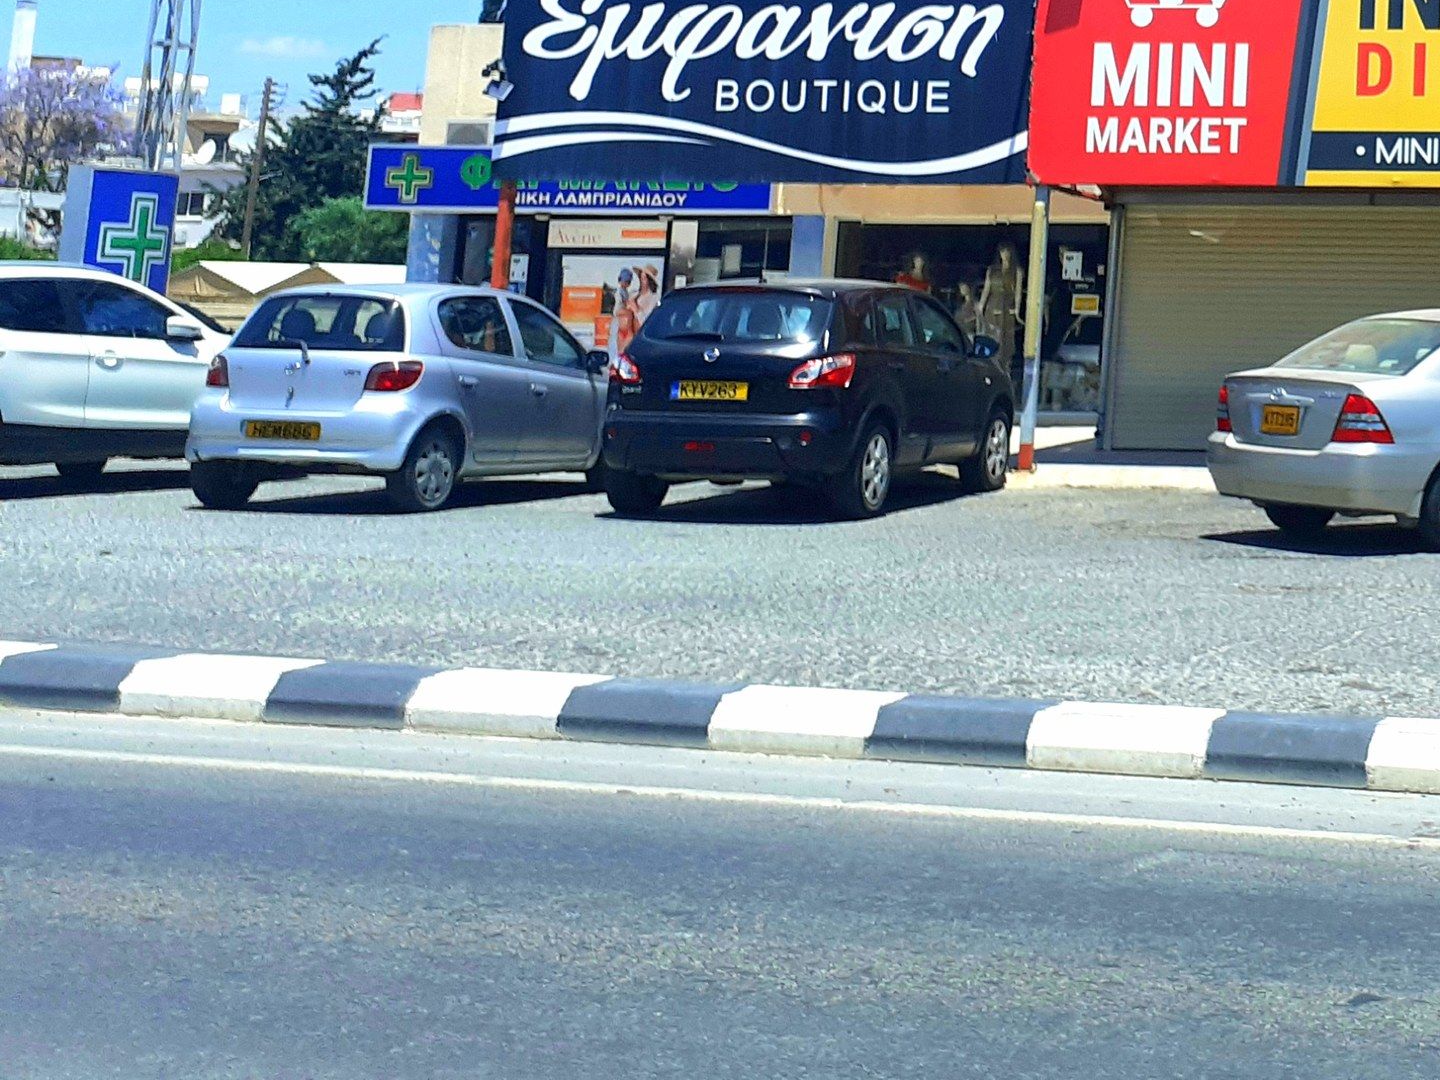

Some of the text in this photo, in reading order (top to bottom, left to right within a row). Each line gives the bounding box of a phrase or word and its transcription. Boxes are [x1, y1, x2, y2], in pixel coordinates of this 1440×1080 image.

[1089, 42, 1250, 108] MINI
[714, 79, 951, 115] BOUTIQUE
[1085, 116, 1248, 155] MARKET
[1374, 137, 1439, 165] MINI
[554, 191, 688, 207] ΛΑΜΠΡΙΑΝΙΔΟΥ
